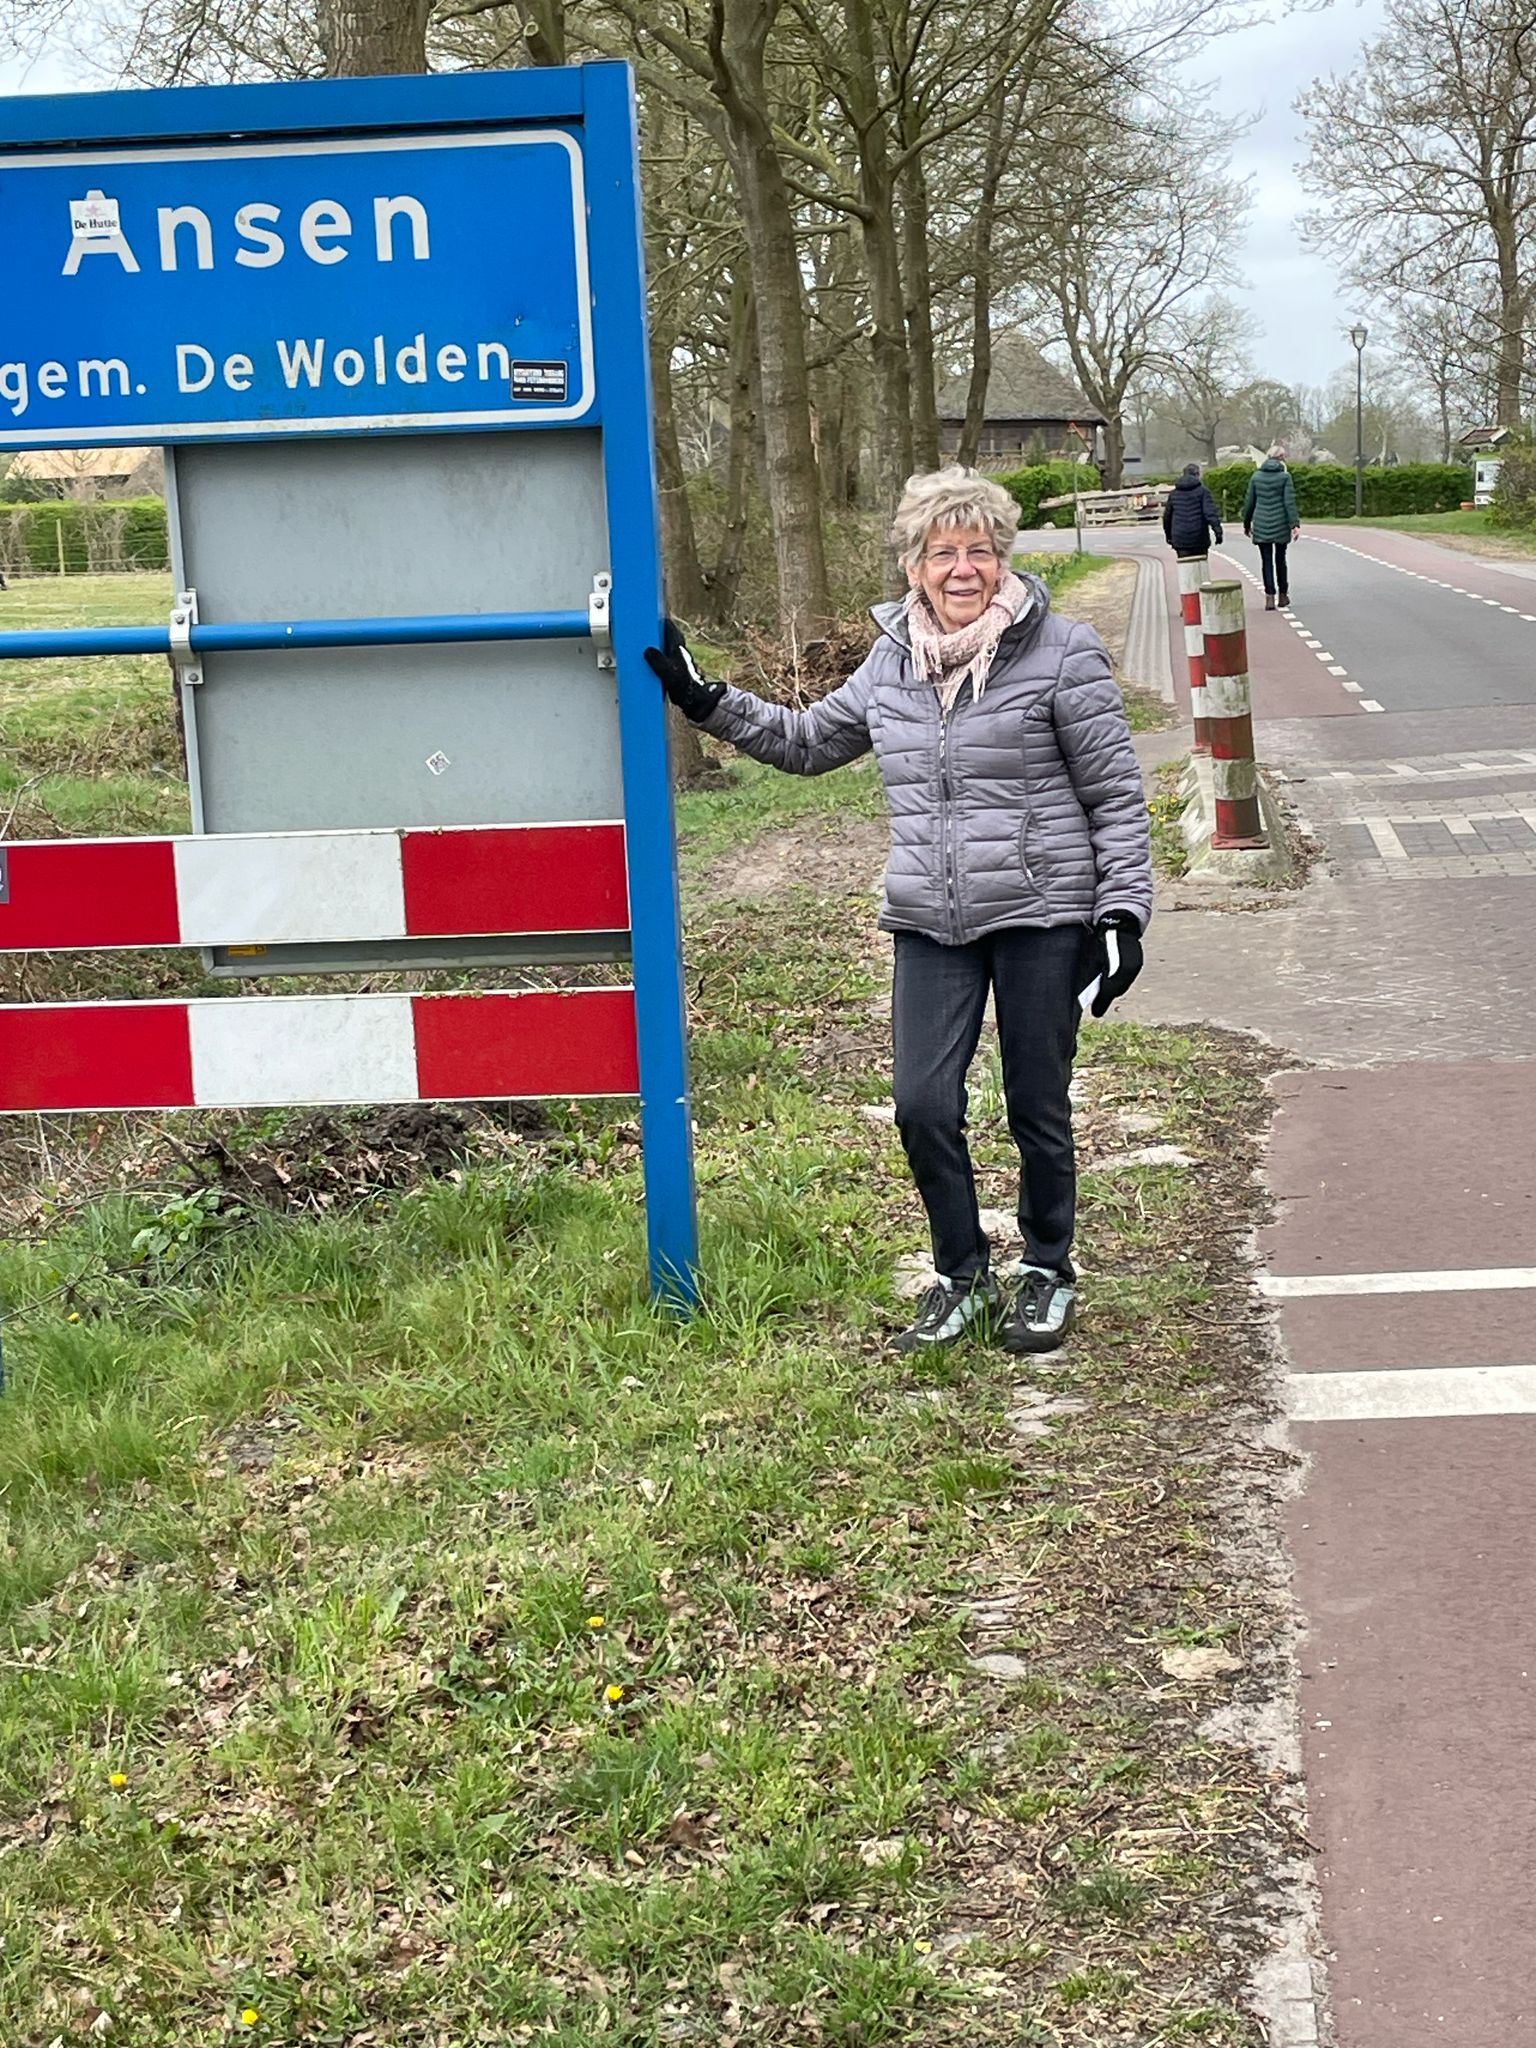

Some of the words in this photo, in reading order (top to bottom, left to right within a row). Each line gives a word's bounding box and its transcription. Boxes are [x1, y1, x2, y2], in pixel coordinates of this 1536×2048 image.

[62, 189, 430, 276] Ansen
[0, 357, 147, 417] gem.
[175, 343, 255, 394] De
[275, 333, 510, 389] Wolden
